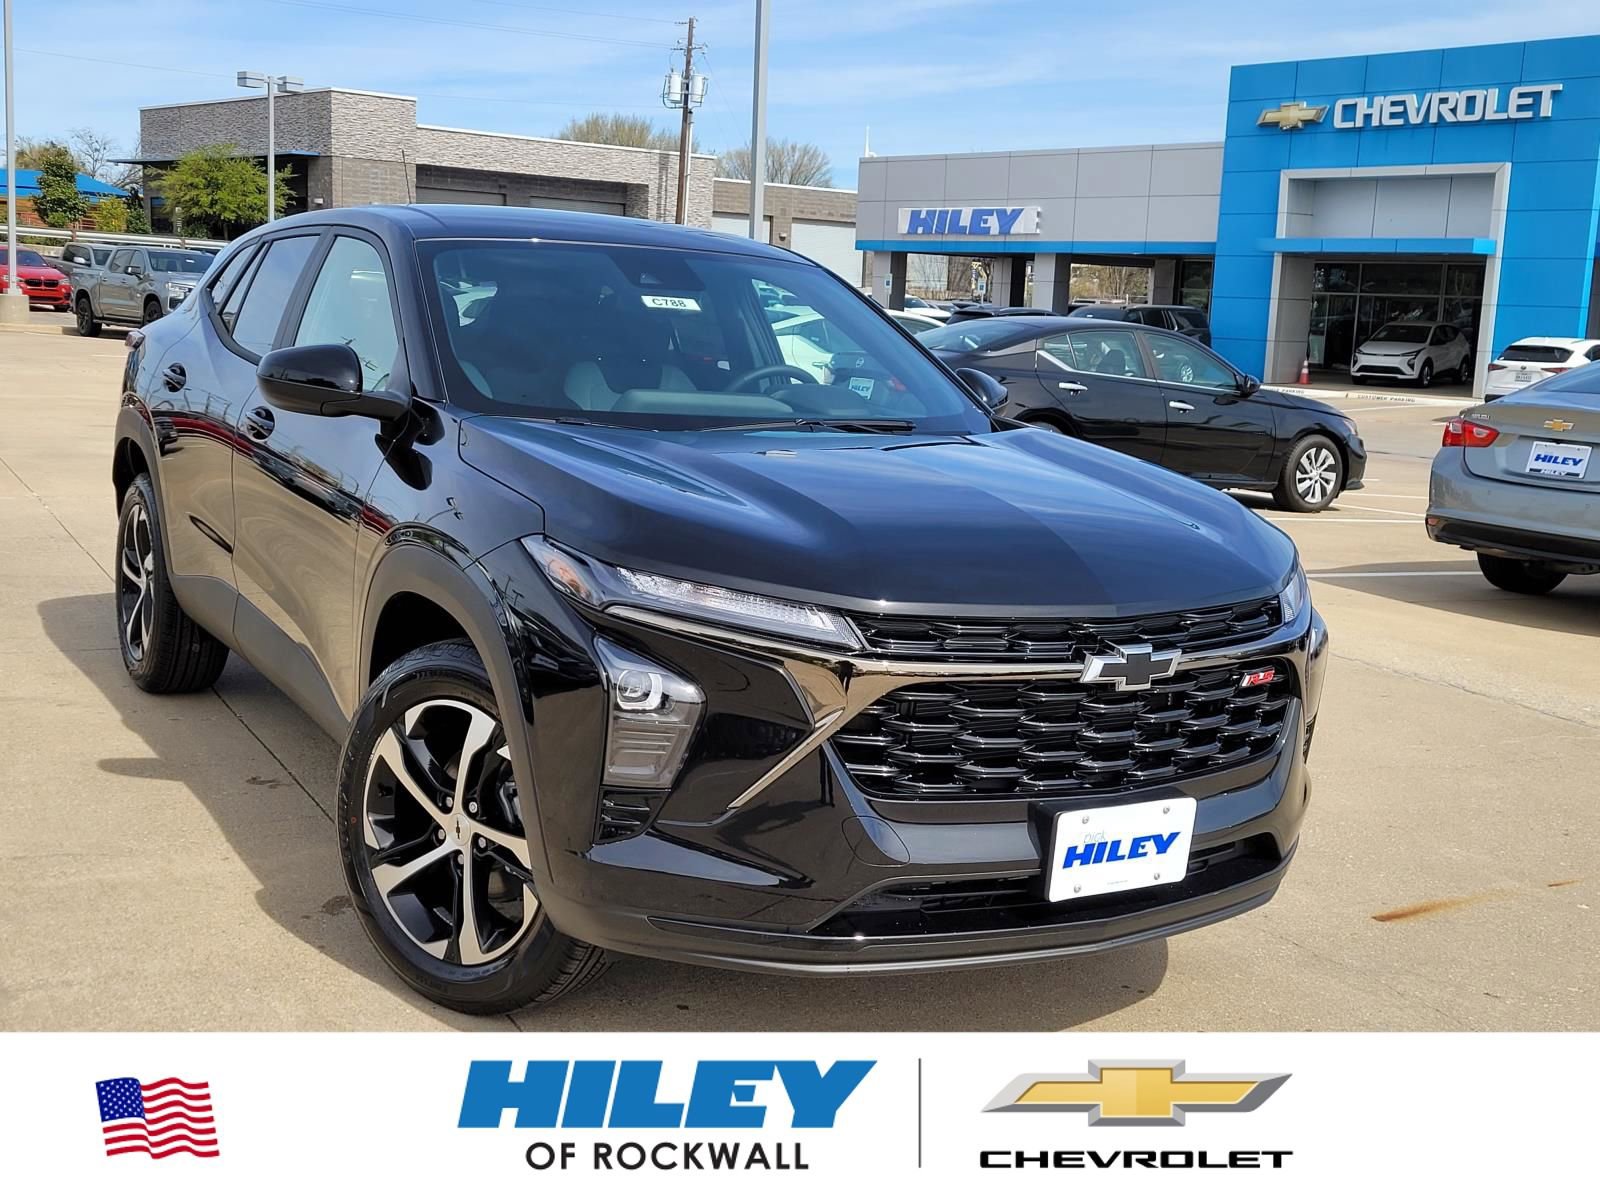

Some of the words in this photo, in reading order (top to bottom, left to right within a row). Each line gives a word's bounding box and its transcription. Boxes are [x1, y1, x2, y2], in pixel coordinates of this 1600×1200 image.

[1333, 84, 1563, 129] CHEVROLET
[906, 208, 1024, 235] HILEY
[652, 298, 687, 308] C788
[1534, 453, 1584, 466] HILEY
[1243, 670, 1275, 686] RS
[1062, 831, 1181, 869] HILEY
